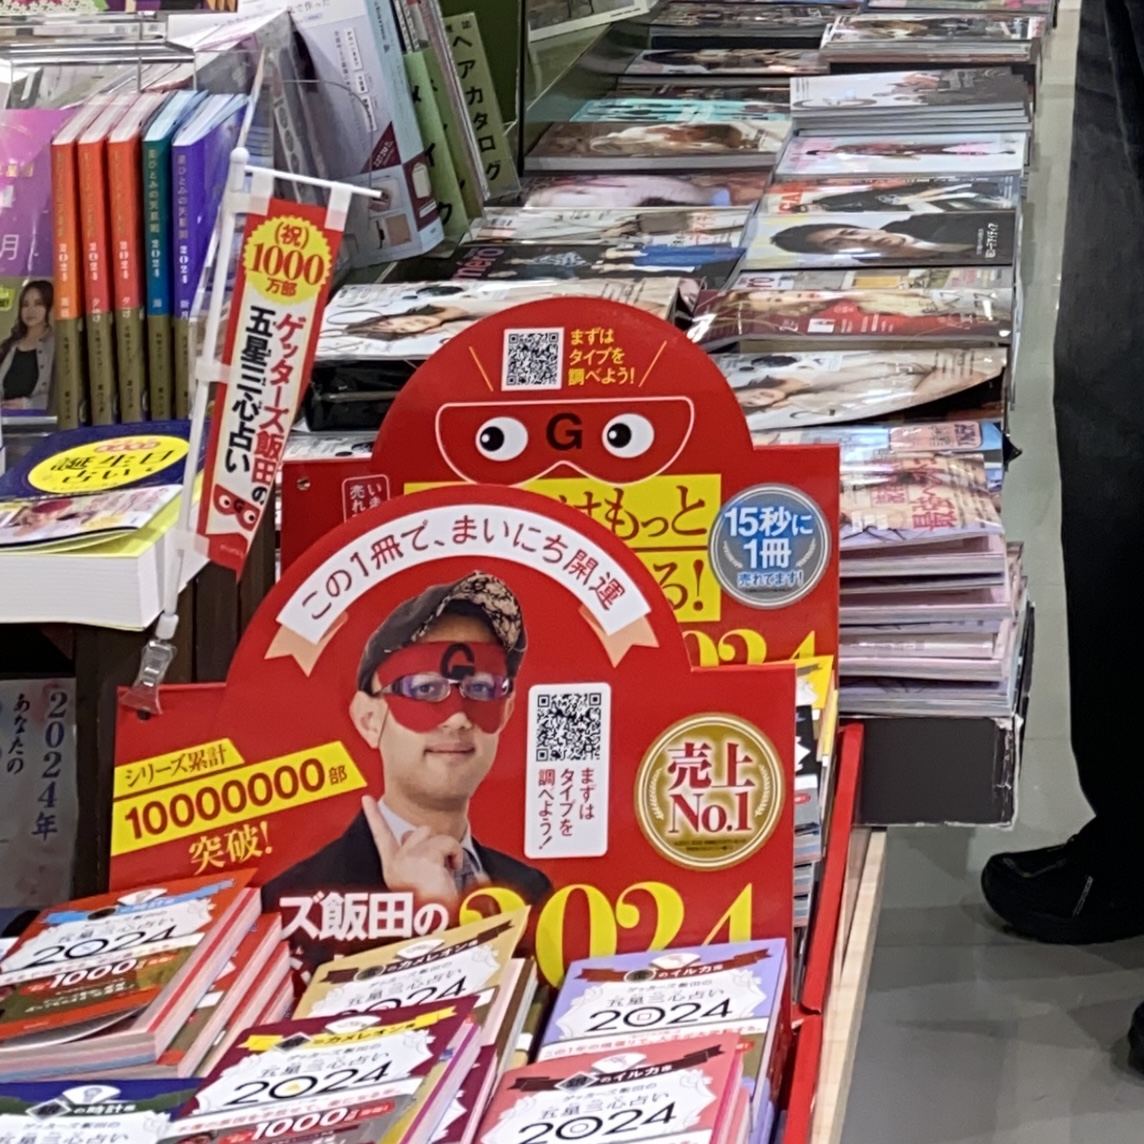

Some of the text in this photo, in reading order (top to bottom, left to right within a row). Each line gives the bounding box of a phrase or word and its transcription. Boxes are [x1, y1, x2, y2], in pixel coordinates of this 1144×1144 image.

[452, 34, 502, 182] ヘアカタログ
[274, 221, 310, 250] (祝)
[58, 243, 69, 282] 2024
[88, 242, 100, 281] 2024
[118, 241, 130, 280] 2024
[151, 238, 161, 278] 2024
[179, 245, 190, 285] 2024
[250, 241, 325, 286] 1000
[265, 277, 299, 297] 万部
[568, 347, 626, 367] タイプを
[570, 327, 615, 346] まずは
[224, 305, 276, 474] 五星三心占い
[567, 367, 636, 386] 調べよう!
[251, 312, 306, 506] ゲッターズ飯田の
[546, 412, 584, 452] G
[724, 506, 814, 538] 15秒に
[301, 514, 627, 621] この1冊で、まいにち開運
[743, 538, 792, 569] 1冊
[736, 570, 804, 588] 売れてます!
[6, 692, 31, 775] あなたの
[31, 691, 69, 841] 2024年
[124, 743, 228, 788] シリーズ累計
[667, 740, 756, 792] 売上
[124, 757, 349, 841] 10000000部
[537, 768, 556, 850] 調べよう!
[559, 768, 576, 837] タイプを
[579, 767, 596, 821] まずは
[667, 791, 753, 835] No.1
[188, 820, 274, 876] 突破!
[279, 890, 450, 942] ズ飯田の
[25, 924, 178, 969] 2024
[50, 958, 138, 989] 1000
[584, 997, 733, 1033] 2024
[223, 1060, 394, 1106] 2024
[250, 1107, 349, 1142] 1000
[514, 1101, 677, 1144] 2024
